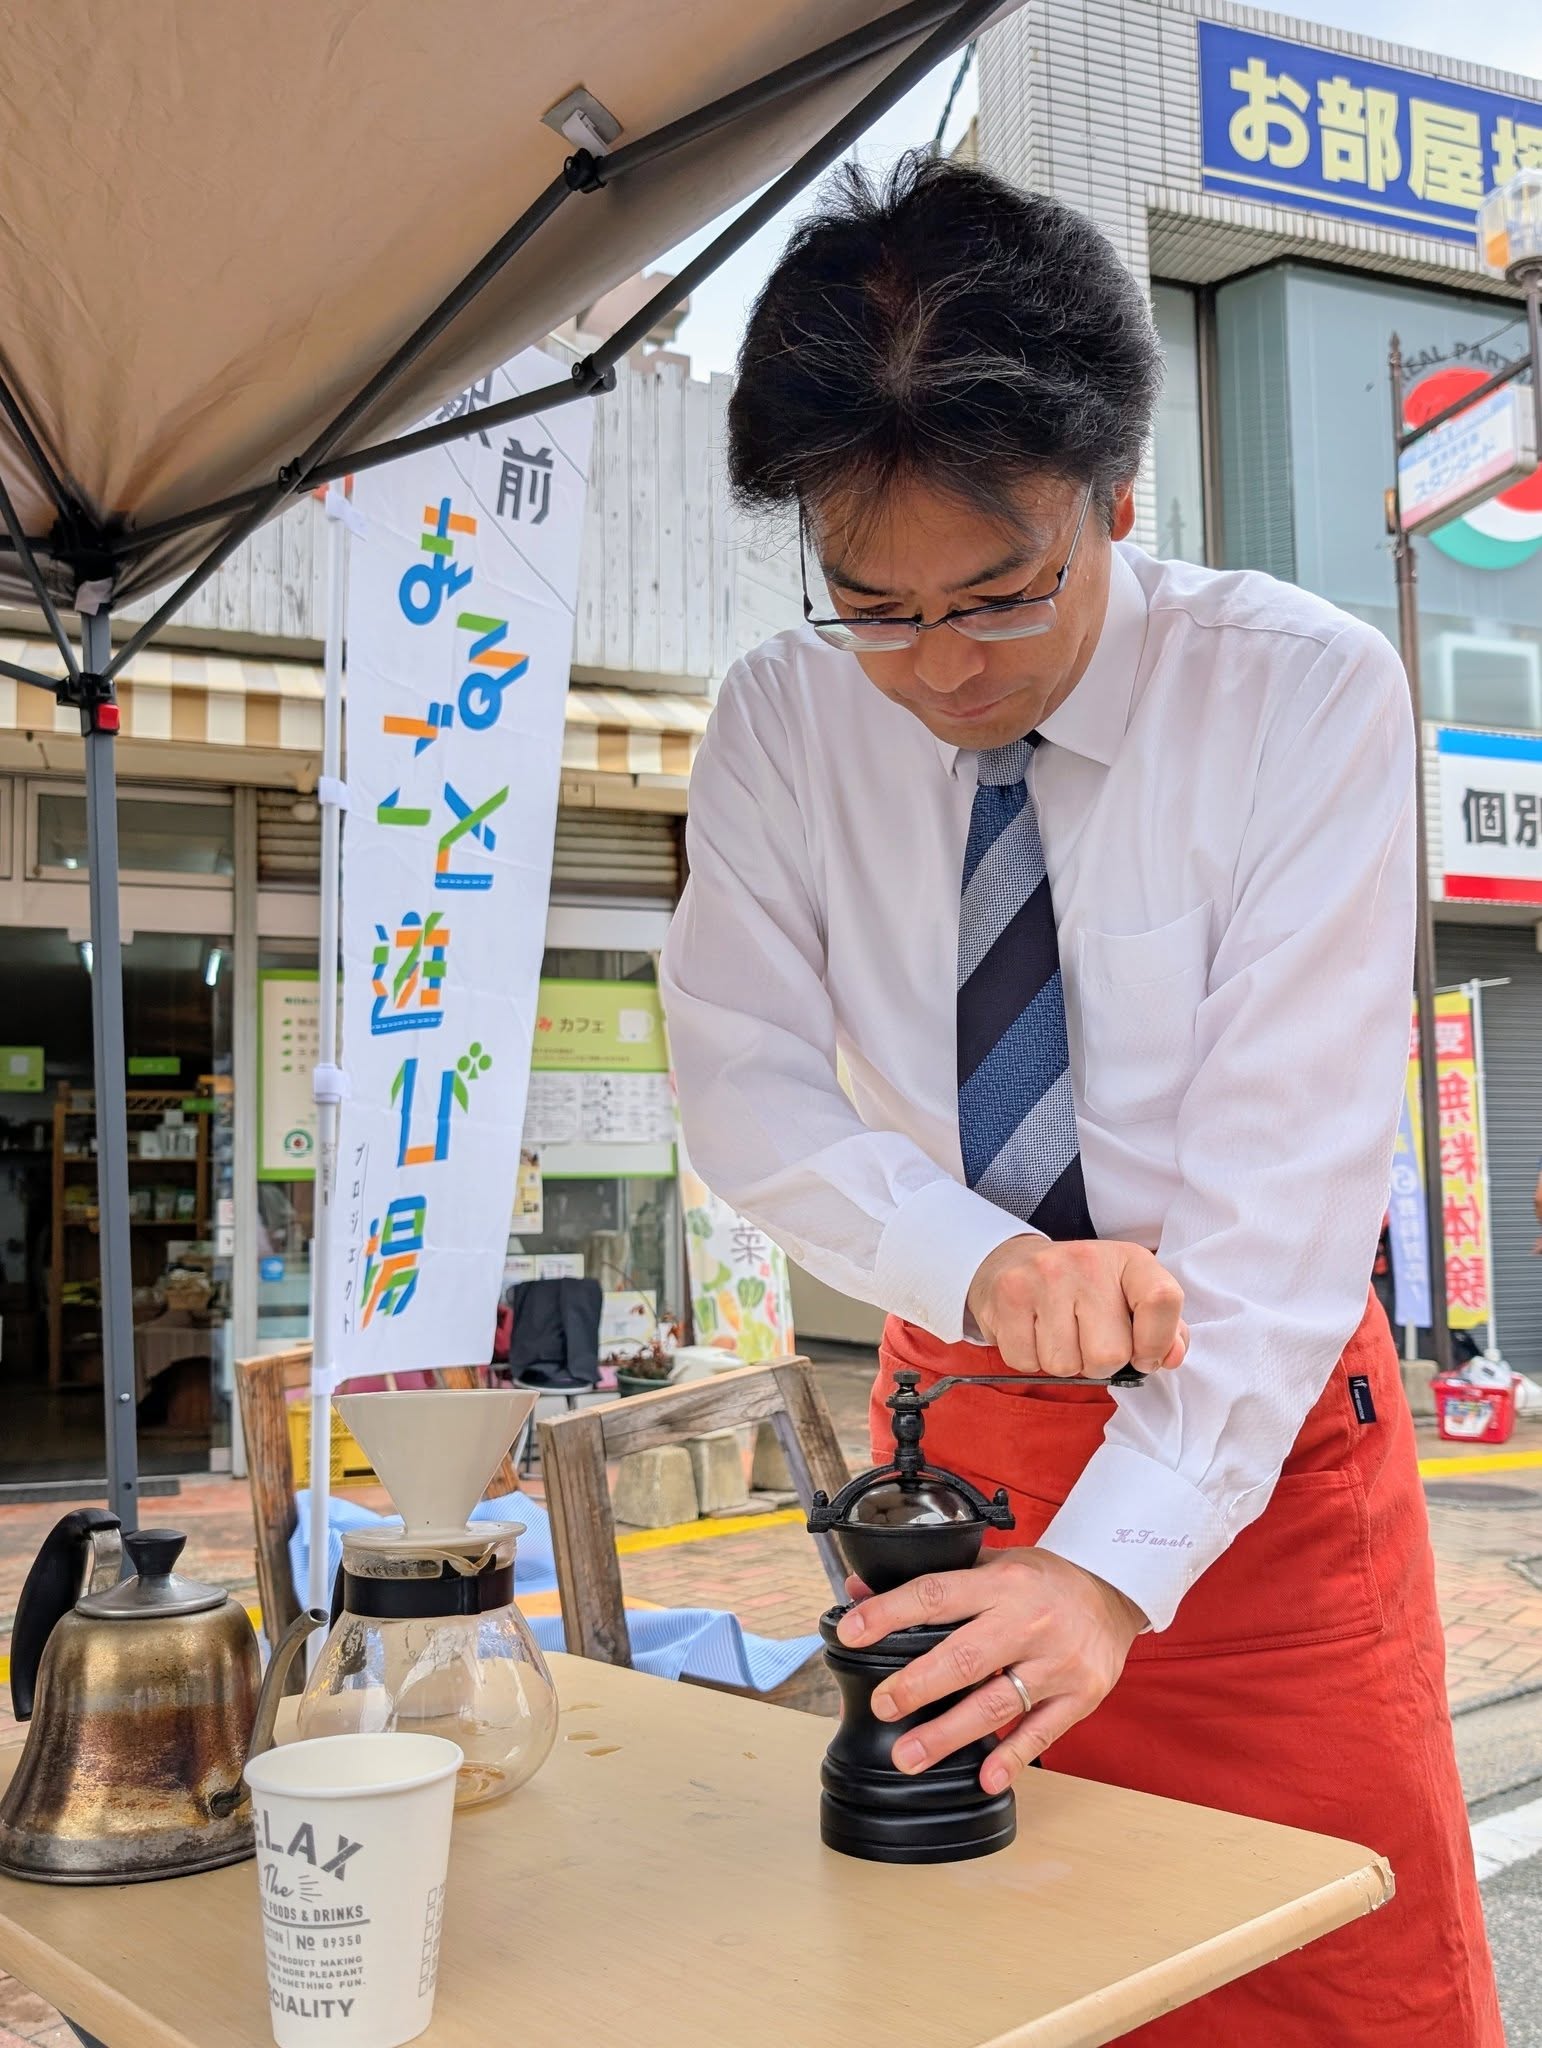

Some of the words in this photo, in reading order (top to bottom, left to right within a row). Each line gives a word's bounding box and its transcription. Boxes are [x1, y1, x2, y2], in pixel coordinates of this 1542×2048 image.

[560, 1017, 605, 1033] カフェ
[263, 1863, 295, 1898] The
[268, 1901, 297, 1921] FOODS
[301, 1909, 309, 1922] &
[313, 1904, 364, 1922] DRINKS
[322, 1933, 362, 1949] 09350
[278, 1953, 316, 1967] PRODUCT
[320, 1955, 363, 1967] MAKING
[282, 1967, 306, 1978] MORE
[309, 1966, 364, 1979] PLEASANT
[278, 1976, 333, 1990] SOMETHING
[339, 1978, 366, 1989] FUN.
[272, 1987, 355, 2018] CIALITY
